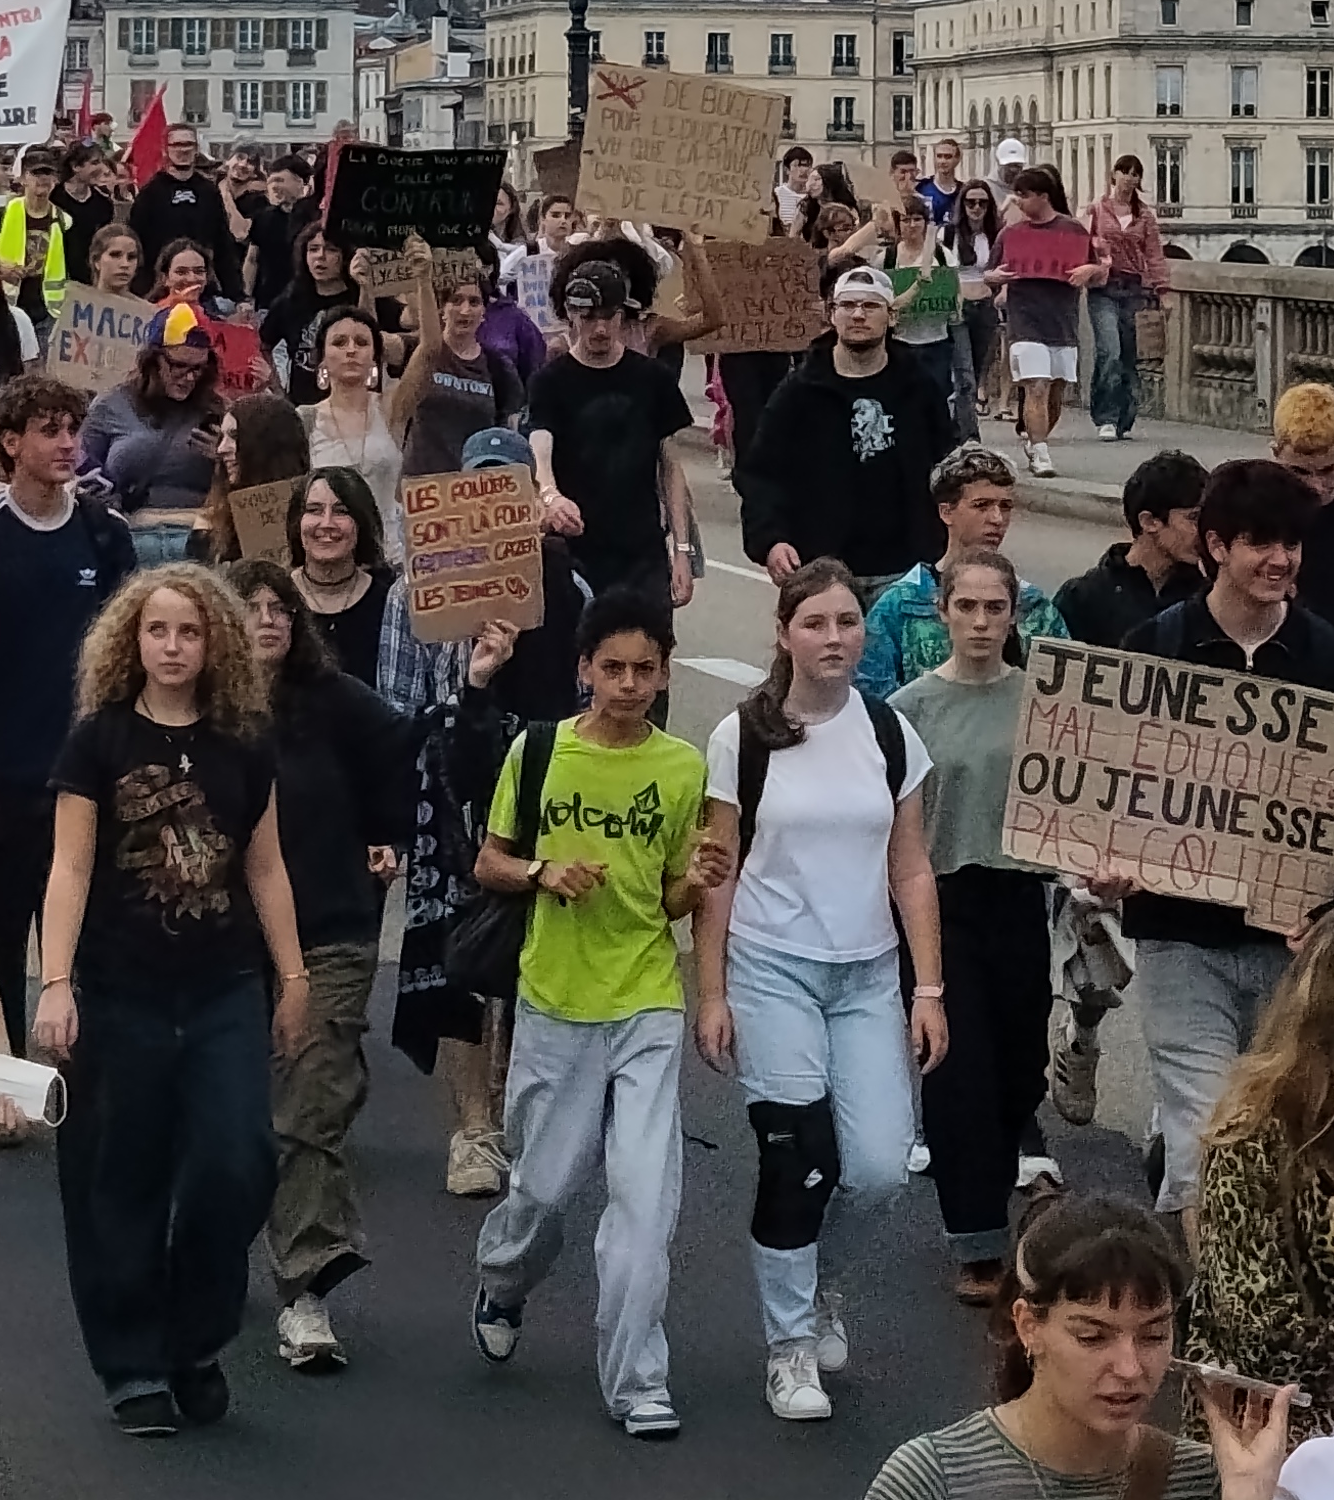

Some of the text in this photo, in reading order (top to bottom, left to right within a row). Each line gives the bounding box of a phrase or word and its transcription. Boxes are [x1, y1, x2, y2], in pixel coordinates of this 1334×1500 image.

[663, 80, 692, 111] DE
[600, 106, 642, 134] POUR
[596, 135, 623, 157] VU
[630, 136, 666, 164] QUE
[655, 167, 687, 191] LES
[621, 184, 647, 212] DE
[73, 300, 157, 347] MACR
[406, 481, 441, 516] LES
[412, 515, 464, 547] SONT
[414, 585, 446, 612] LES
[1035, 644, 1334, 754] JEUNESSE
[1025, 697, 1109, 764] MAL
[1017, 751, 1088, 806] OU
[1005, 800, 1103, 873] PAS
